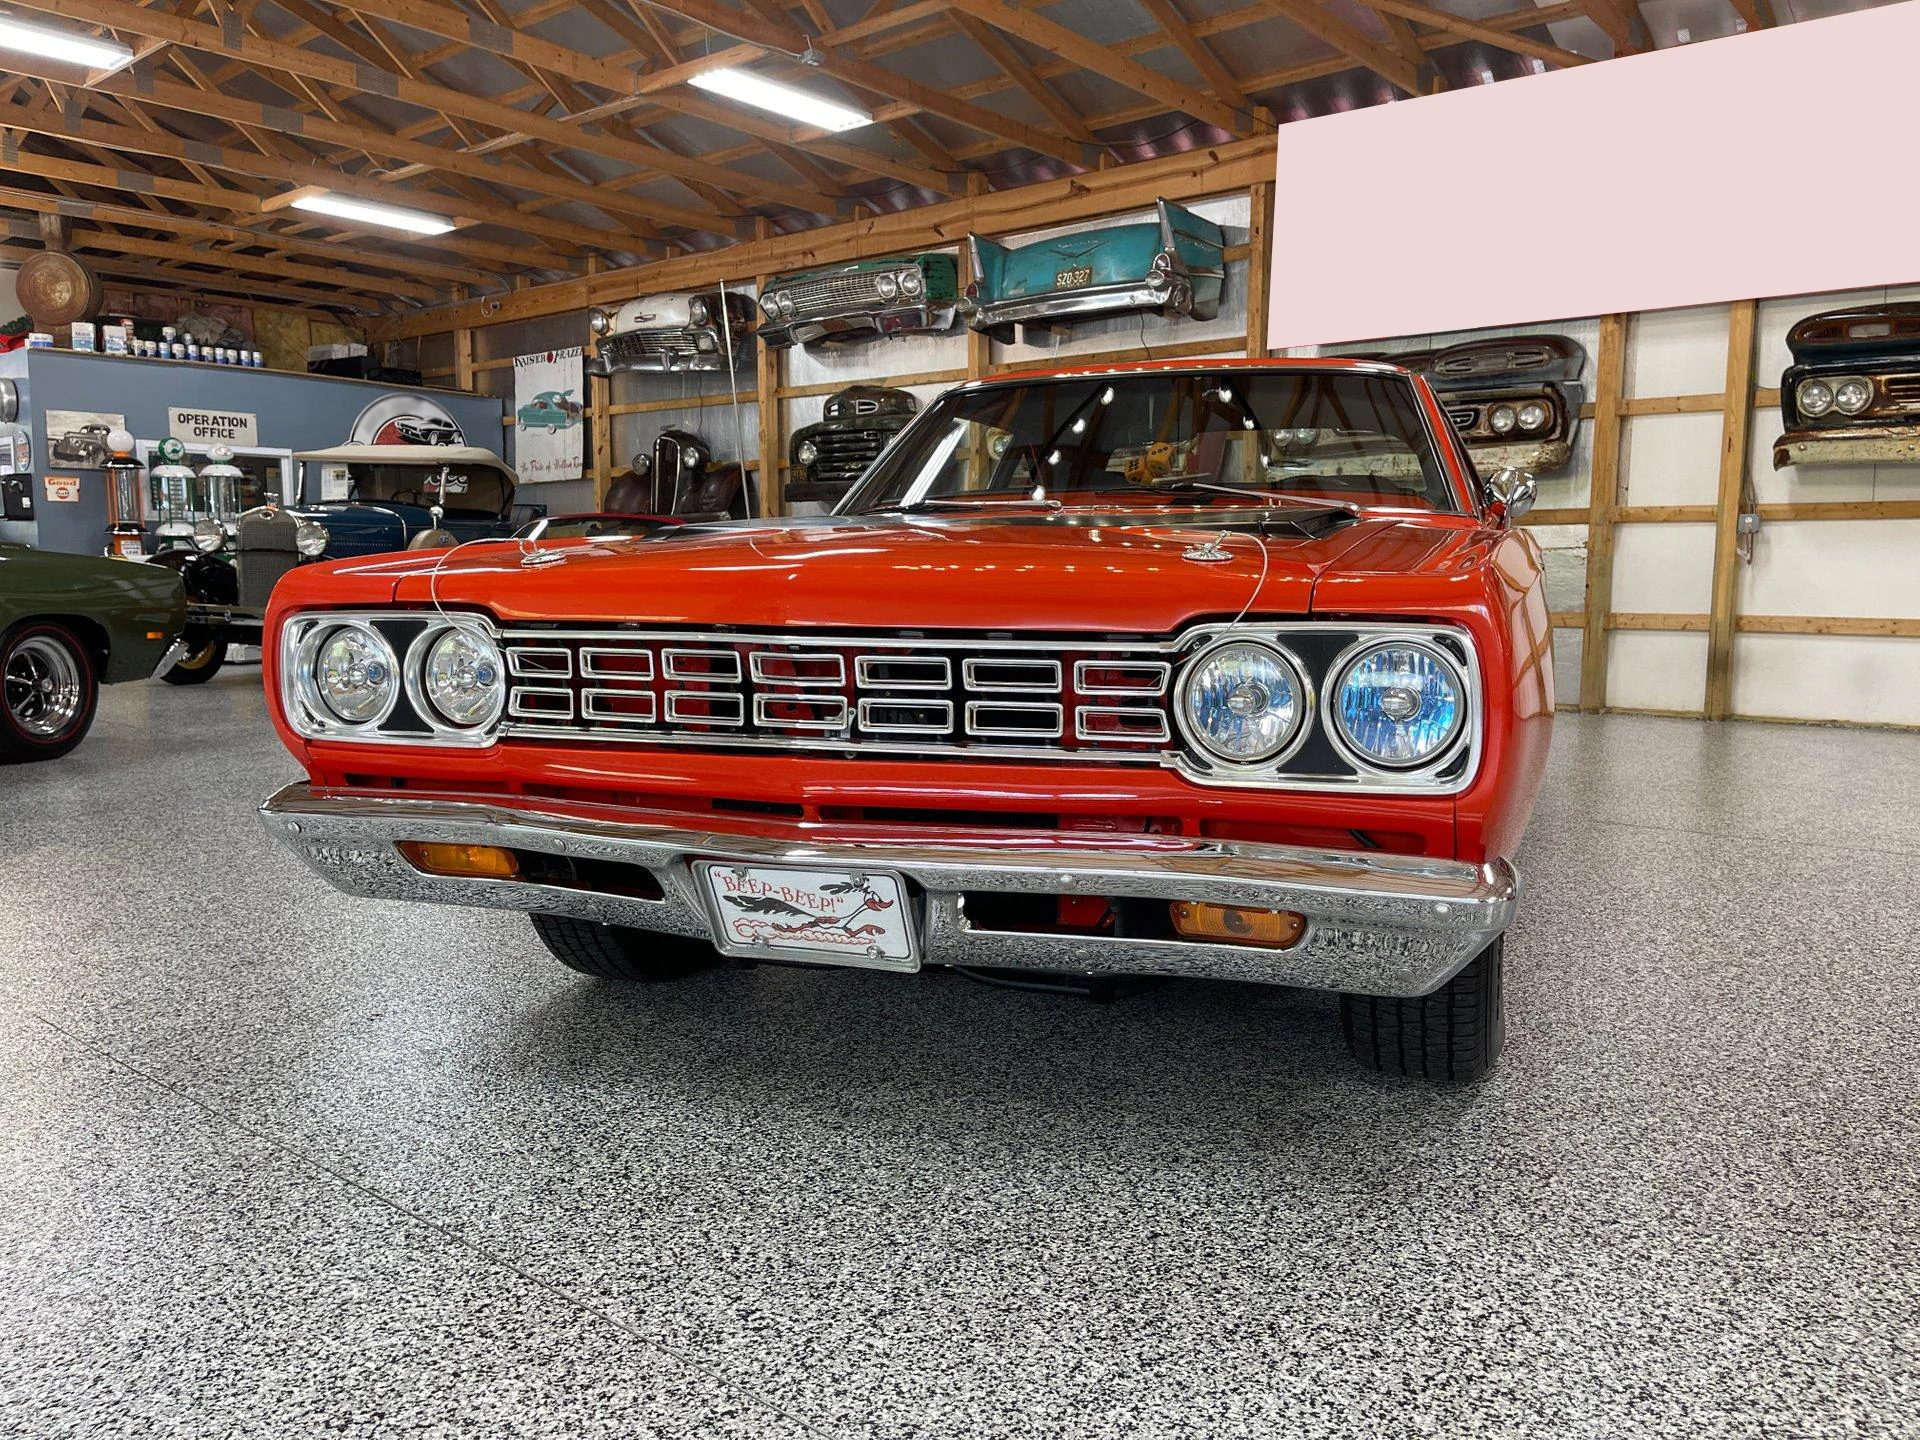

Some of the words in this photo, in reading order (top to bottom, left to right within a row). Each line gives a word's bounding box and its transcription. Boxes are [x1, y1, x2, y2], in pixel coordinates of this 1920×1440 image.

[553, 347, 582, 363] FRAZE
[178, 413, 248, 428] OPERATION
[193, 427, 235, 439] OFFICE
